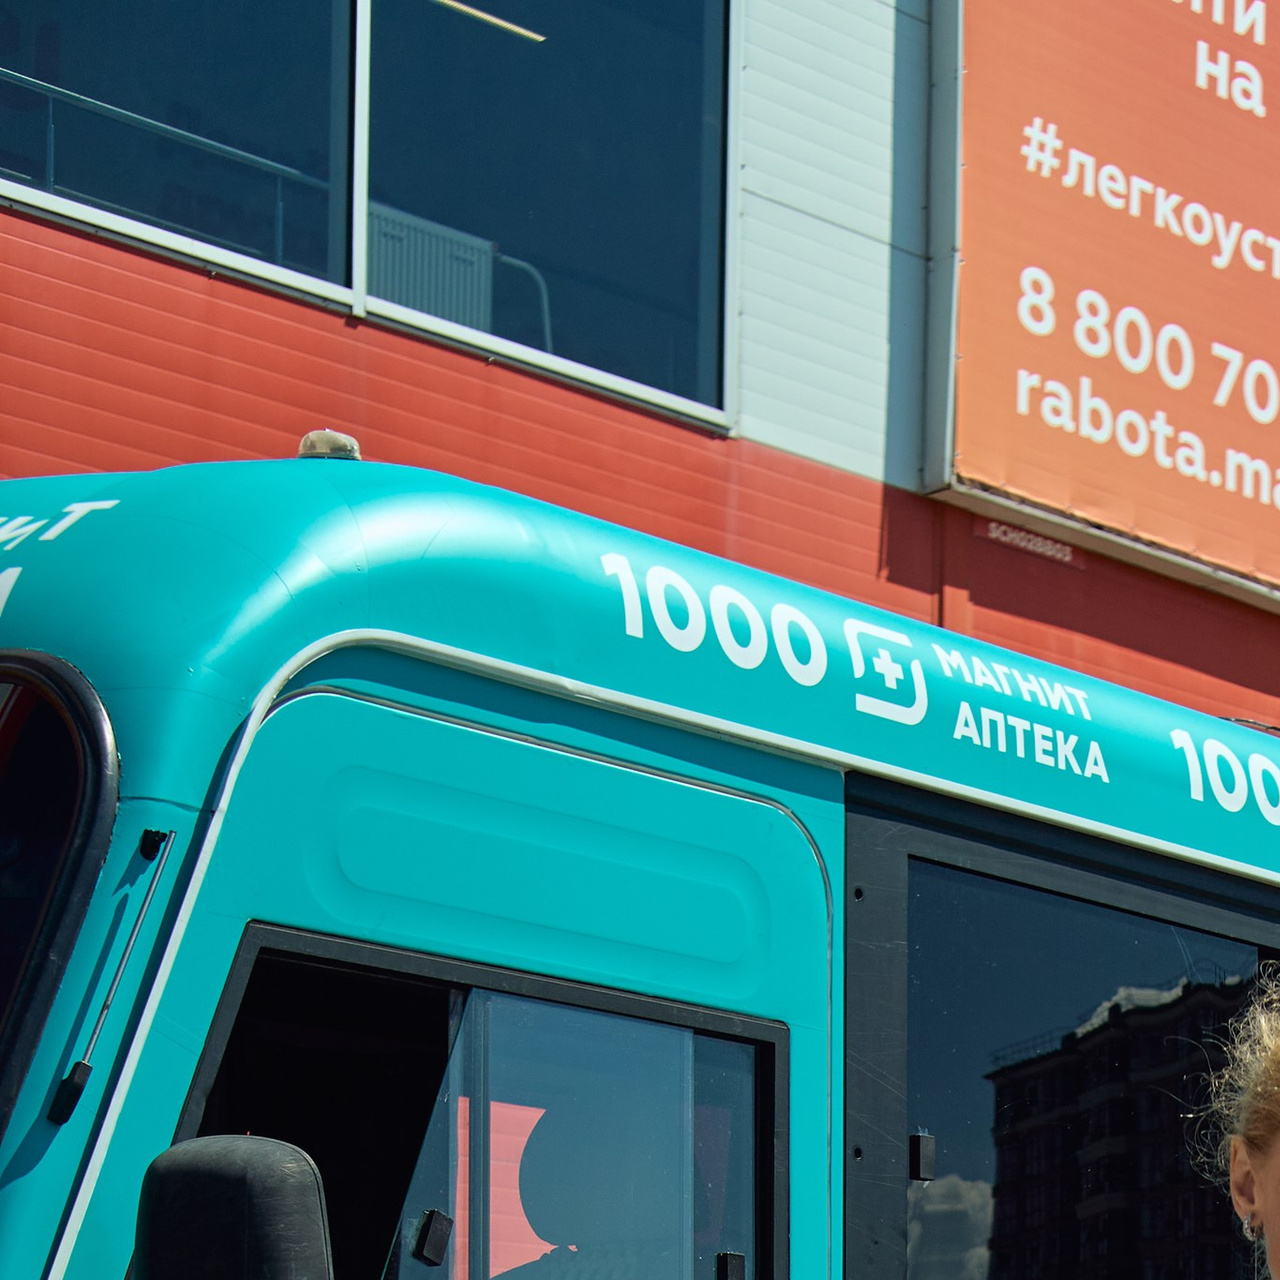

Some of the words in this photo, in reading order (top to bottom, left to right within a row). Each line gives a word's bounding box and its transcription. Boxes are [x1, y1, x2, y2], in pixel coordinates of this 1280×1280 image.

[1195, 39, 1266, 118] на
[1017, 266, 1056, 336] 8
[1073, 289, 1194, 390] 800
[601, 552, 828, 687] 1000
[931, 642, 1089, 721] МАГНИТ
[953, 700, 1110, 784] АПТЕКА
